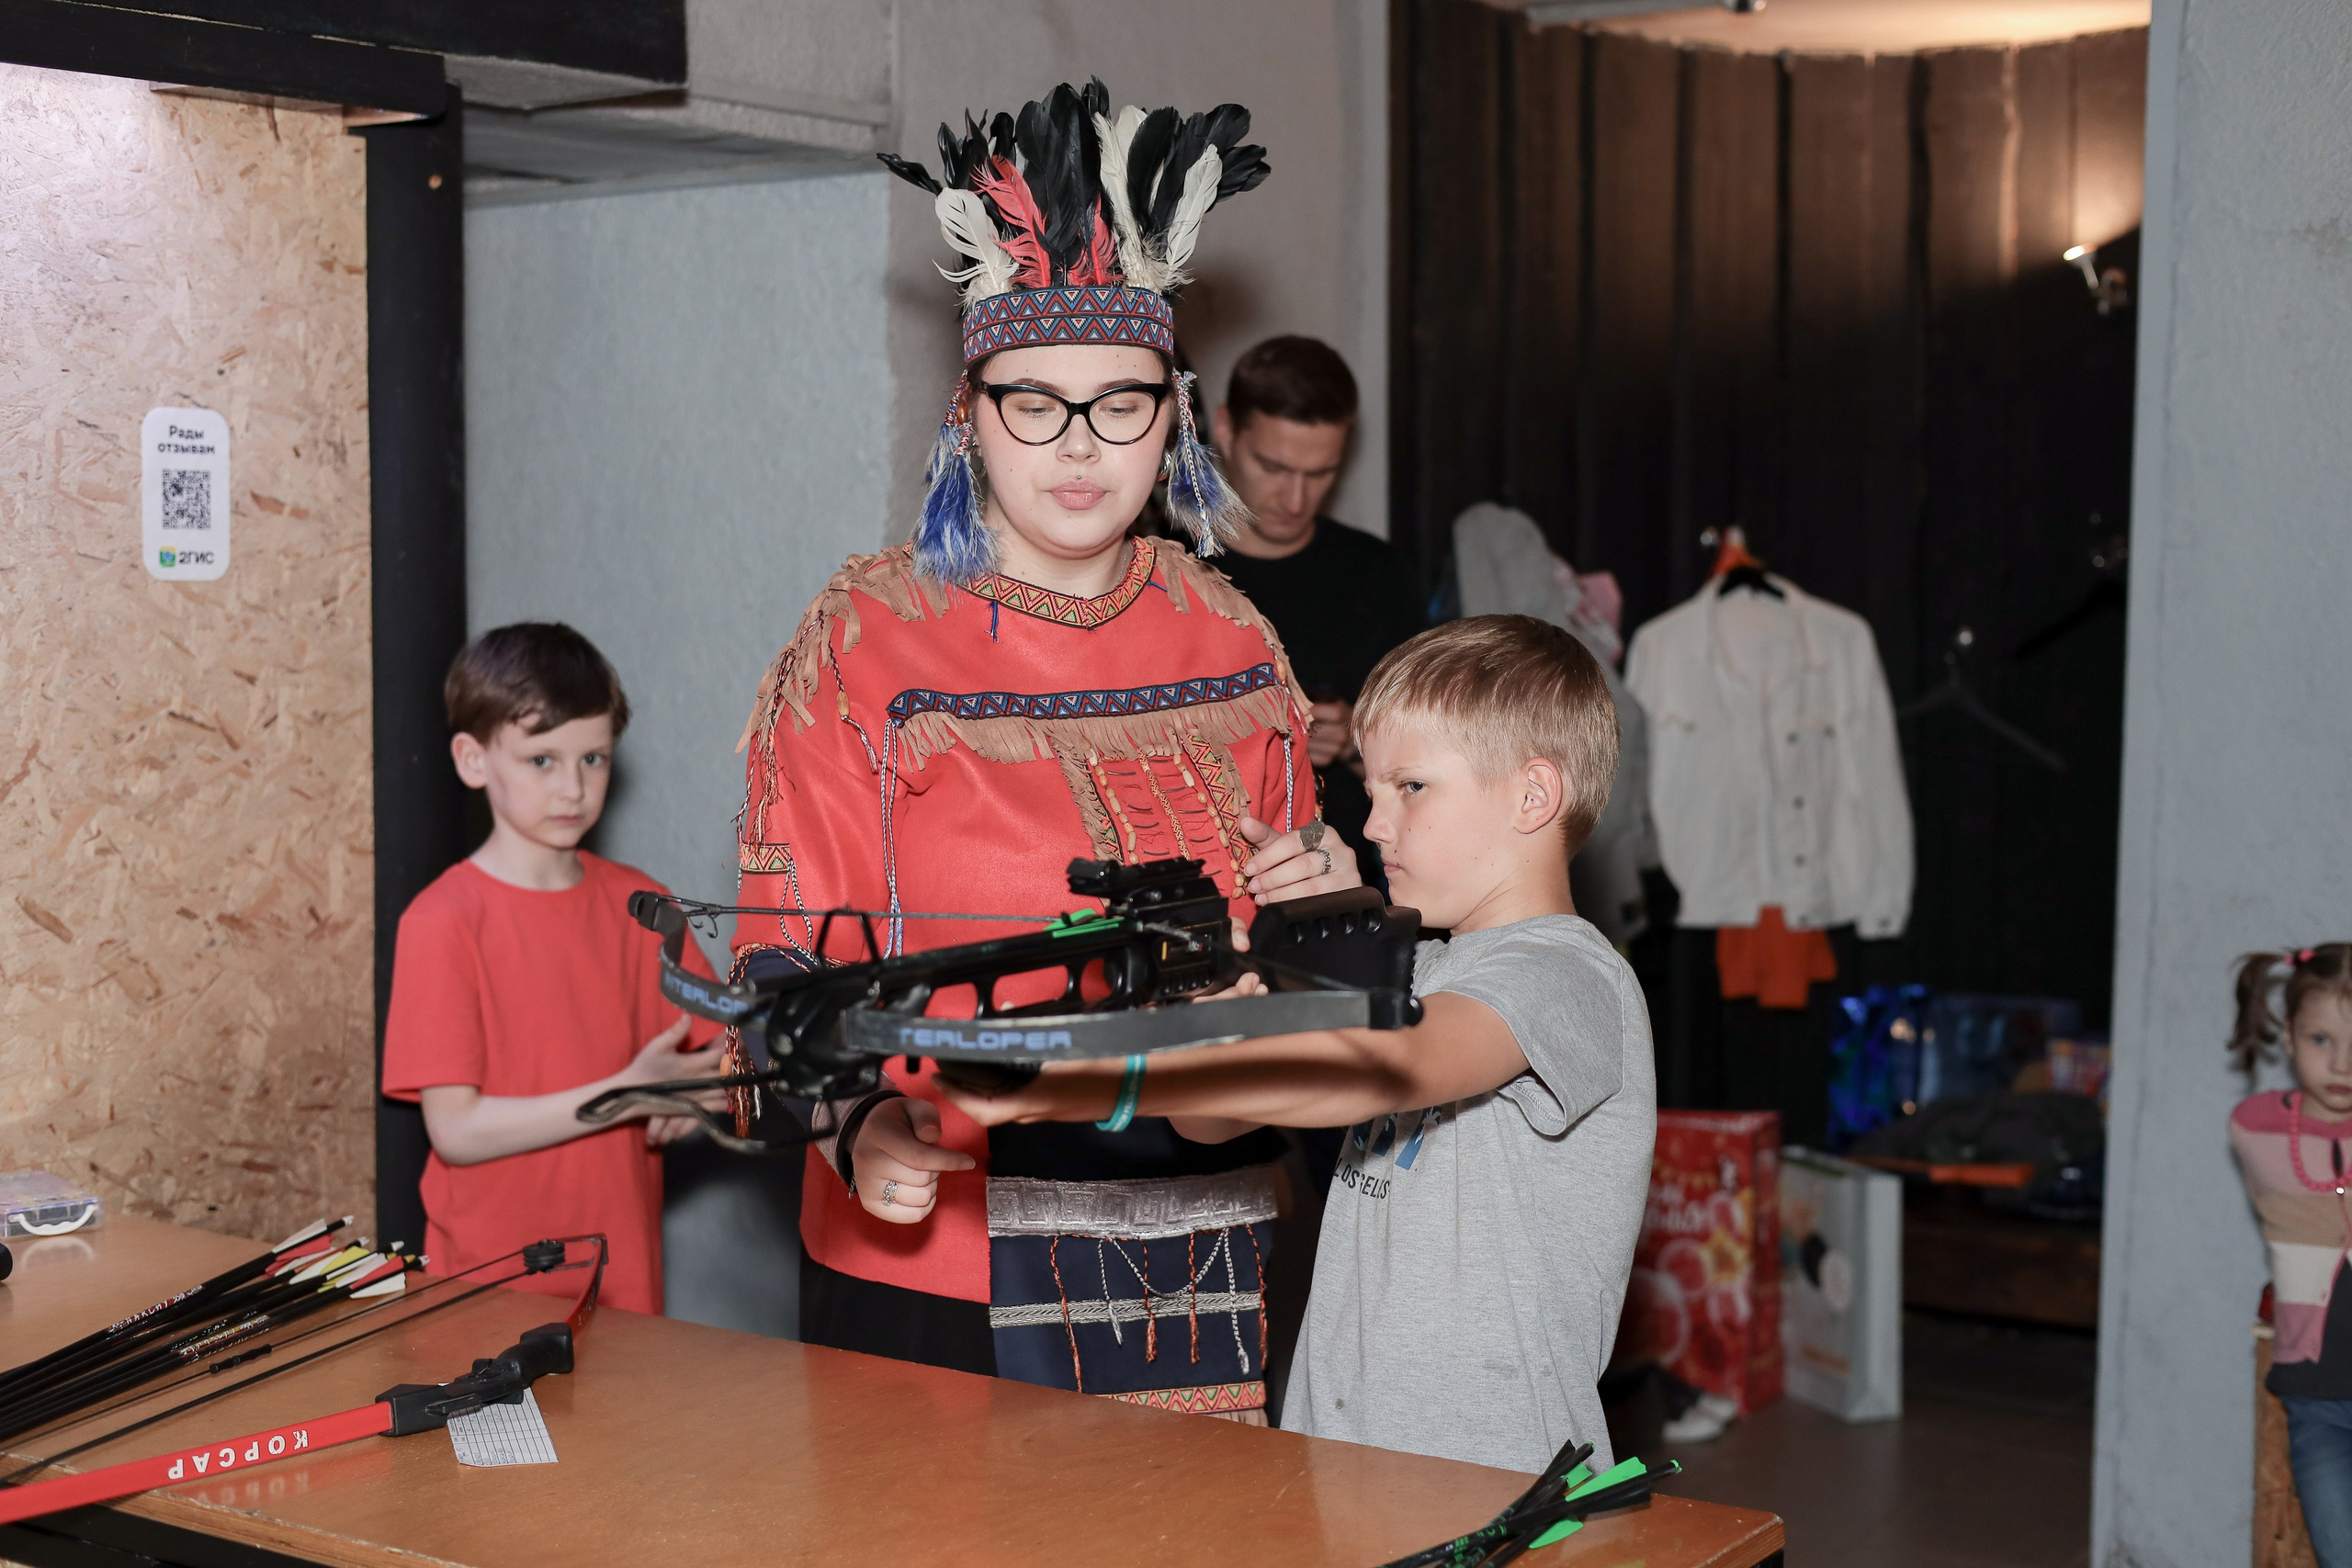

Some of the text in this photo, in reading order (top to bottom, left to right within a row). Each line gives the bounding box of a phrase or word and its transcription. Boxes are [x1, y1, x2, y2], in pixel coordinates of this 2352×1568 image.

[169, 425, 204, 439] Рады
[157, 442, 215, 455] отзывам
[178, 551, 214, 565] 2ГИС
[167, 1429, 309, 1480] КОРСАР
